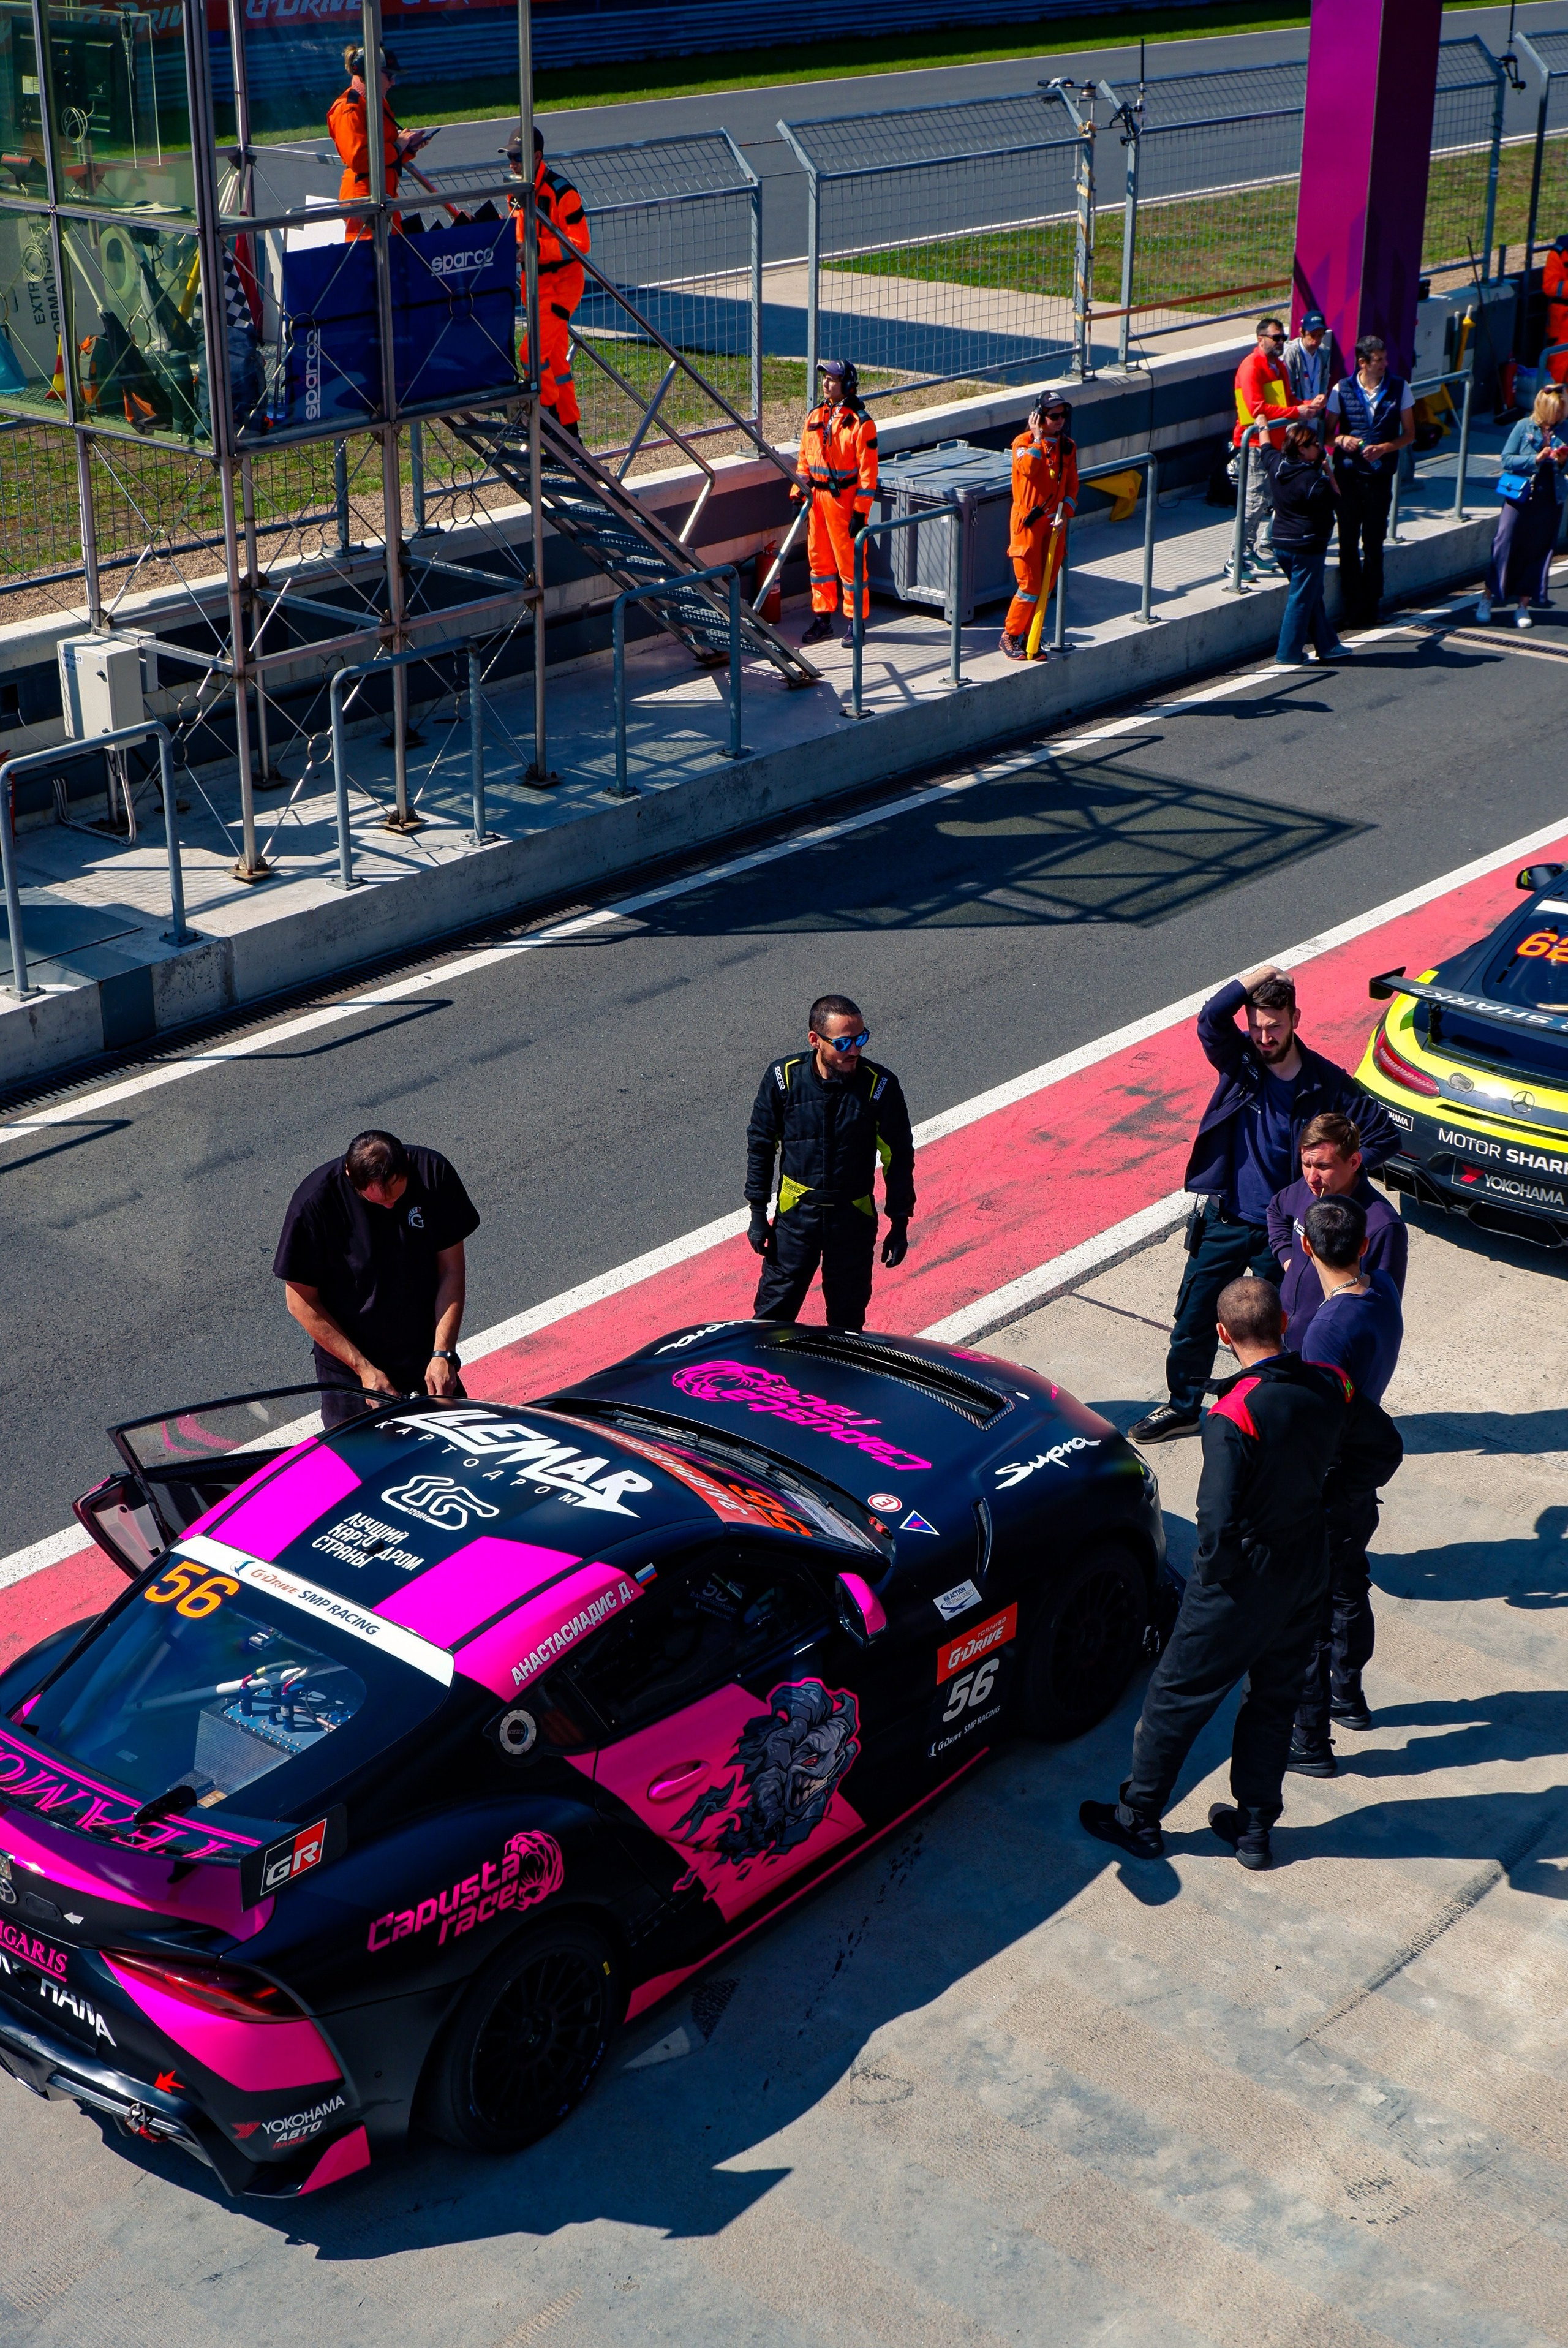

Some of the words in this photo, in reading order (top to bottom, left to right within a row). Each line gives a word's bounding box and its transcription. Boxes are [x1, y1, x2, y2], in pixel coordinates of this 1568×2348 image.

[431, 247, 494, 276] sparco
[306, 328, 321, 420] sparco
[1409, 988, 1553, 1024] SHARKS
[774, 1066, 786, 1090] sparco
[873, 1076, 888, 1101] sparco
[1438, 1127, 1501, 1159] MOTOR
[1485, 1174, 1565, 1206] YOKOHAMA
[375, 1421, 579, 1504] КАРТОДРОМ
[995, 1437, 1101, 1489] Supra
[343, 1512, 409, 1545] ЛУЧШИЙ
[312, 1535, 374, 1568] СТРАНЫ
[144, 1561, 239, 1618] 56
[950, 1586, 967, 1598] ACTION
[961, 1588, 975, 1599] SAFETY
[298, 1590, 331, 1608] SMP
[326, 1604, 380, 1636] RACING
[978, 1617, 1006, 1637] ТОПЛИВО
[511, 1591, 617, 1686] АНАСТАСИАДИС
[618, 1581, 634, 1604] Д.
[943, 1658, 1000, 1723] 56
[963, 1719, 977, 1734] SMP
[977, 1705, 1001, 1725] RACING
[266, 1841, 318, 1886] GR
[367, 1852, 521, 1952] Capusta
[438, 1879, 519, 1946] race
[0, 1920, 67, 1973] GARIS
[262, 2095, 345, 2134] YOKOHAMA
